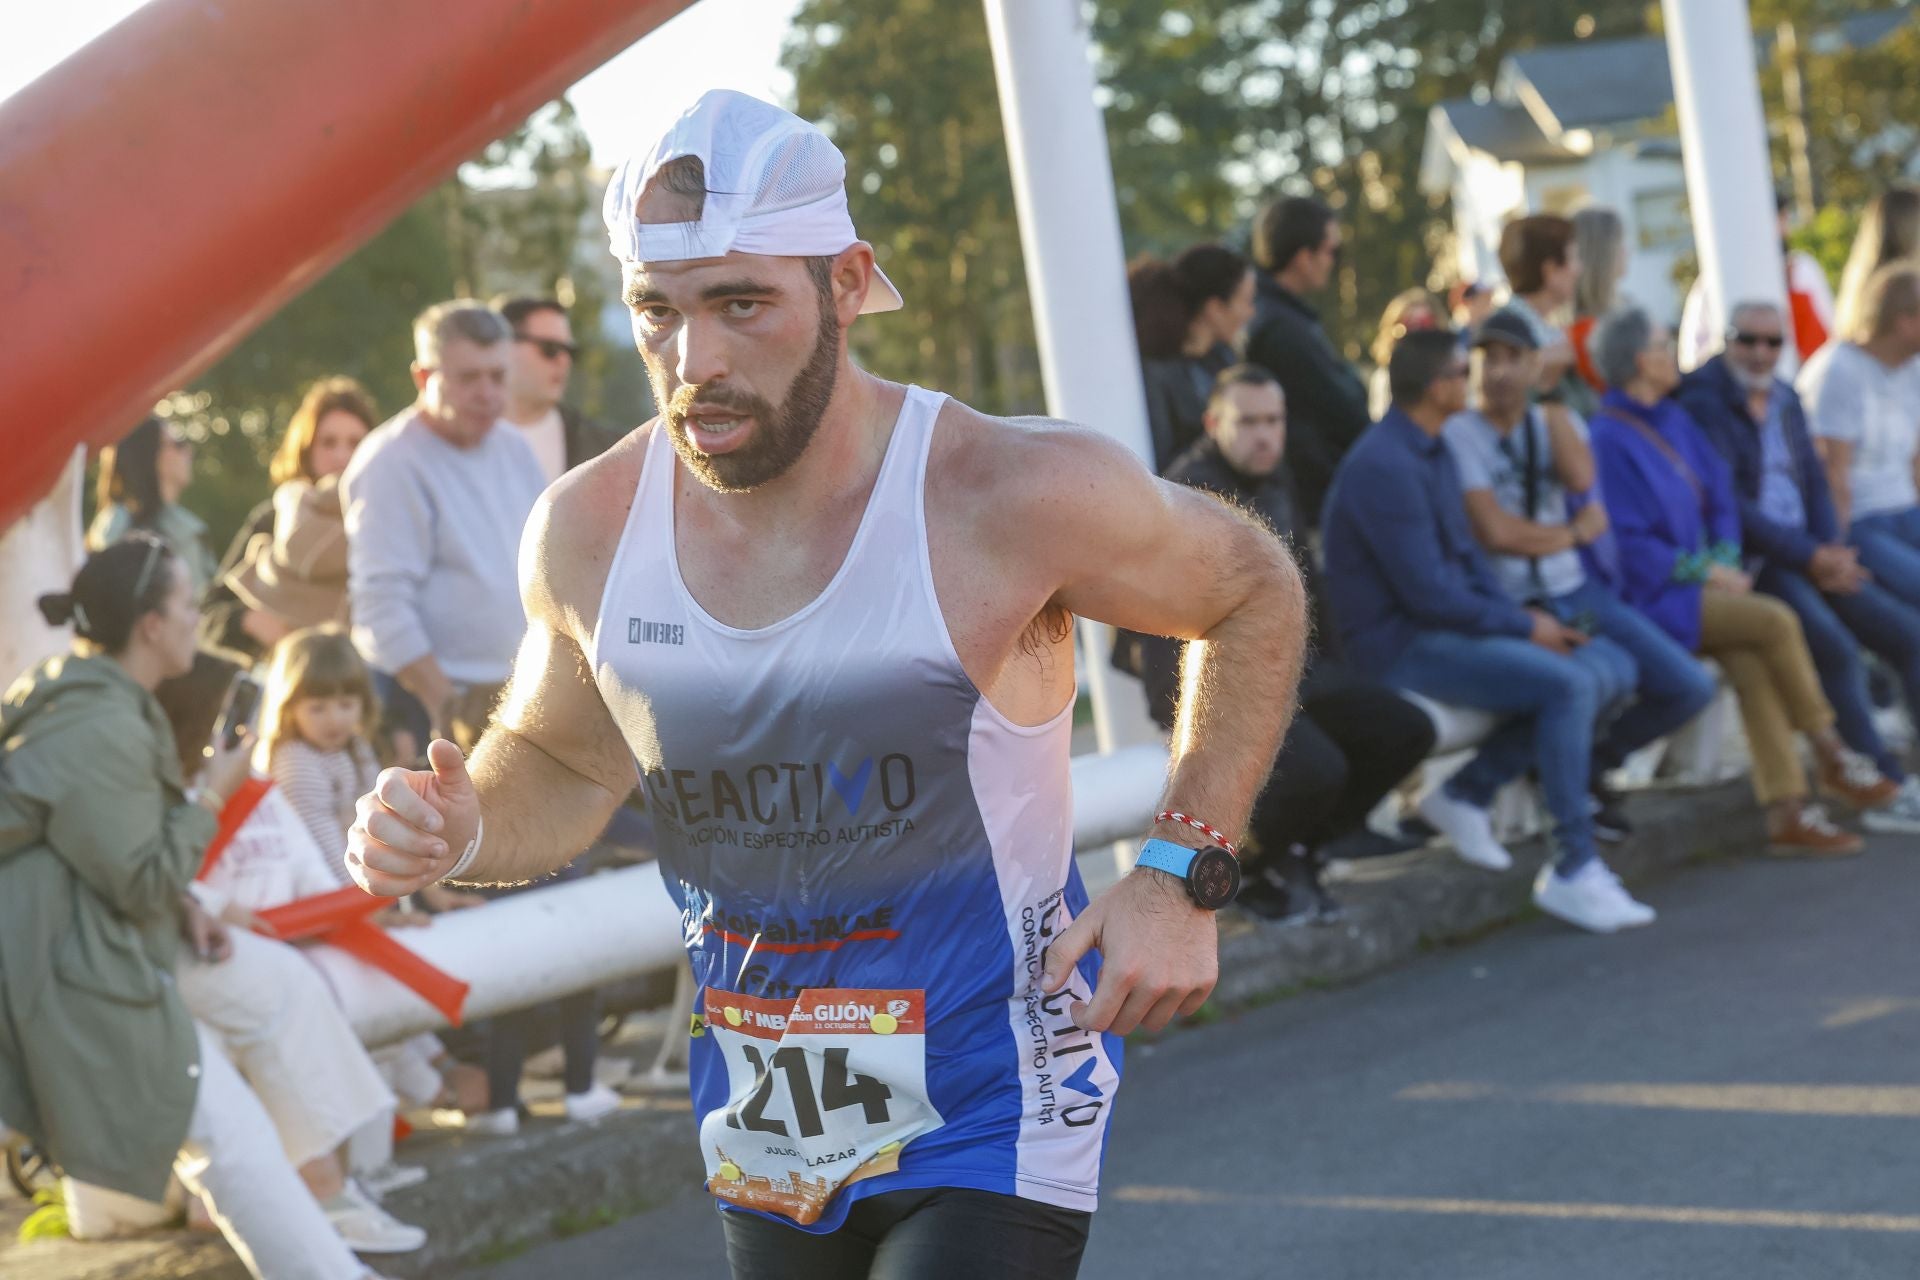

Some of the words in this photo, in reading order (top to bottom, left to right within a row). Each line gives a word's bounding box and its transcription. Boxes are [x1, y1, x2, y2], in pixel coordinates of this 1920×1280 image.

[744, 829, 831, 849] ESPECTRO
[836, 818, 915, 845] AUTISTA
[813, 1001, 875, 1022] GIJÓN
[765, 1146, 796, 1157] JULIO
